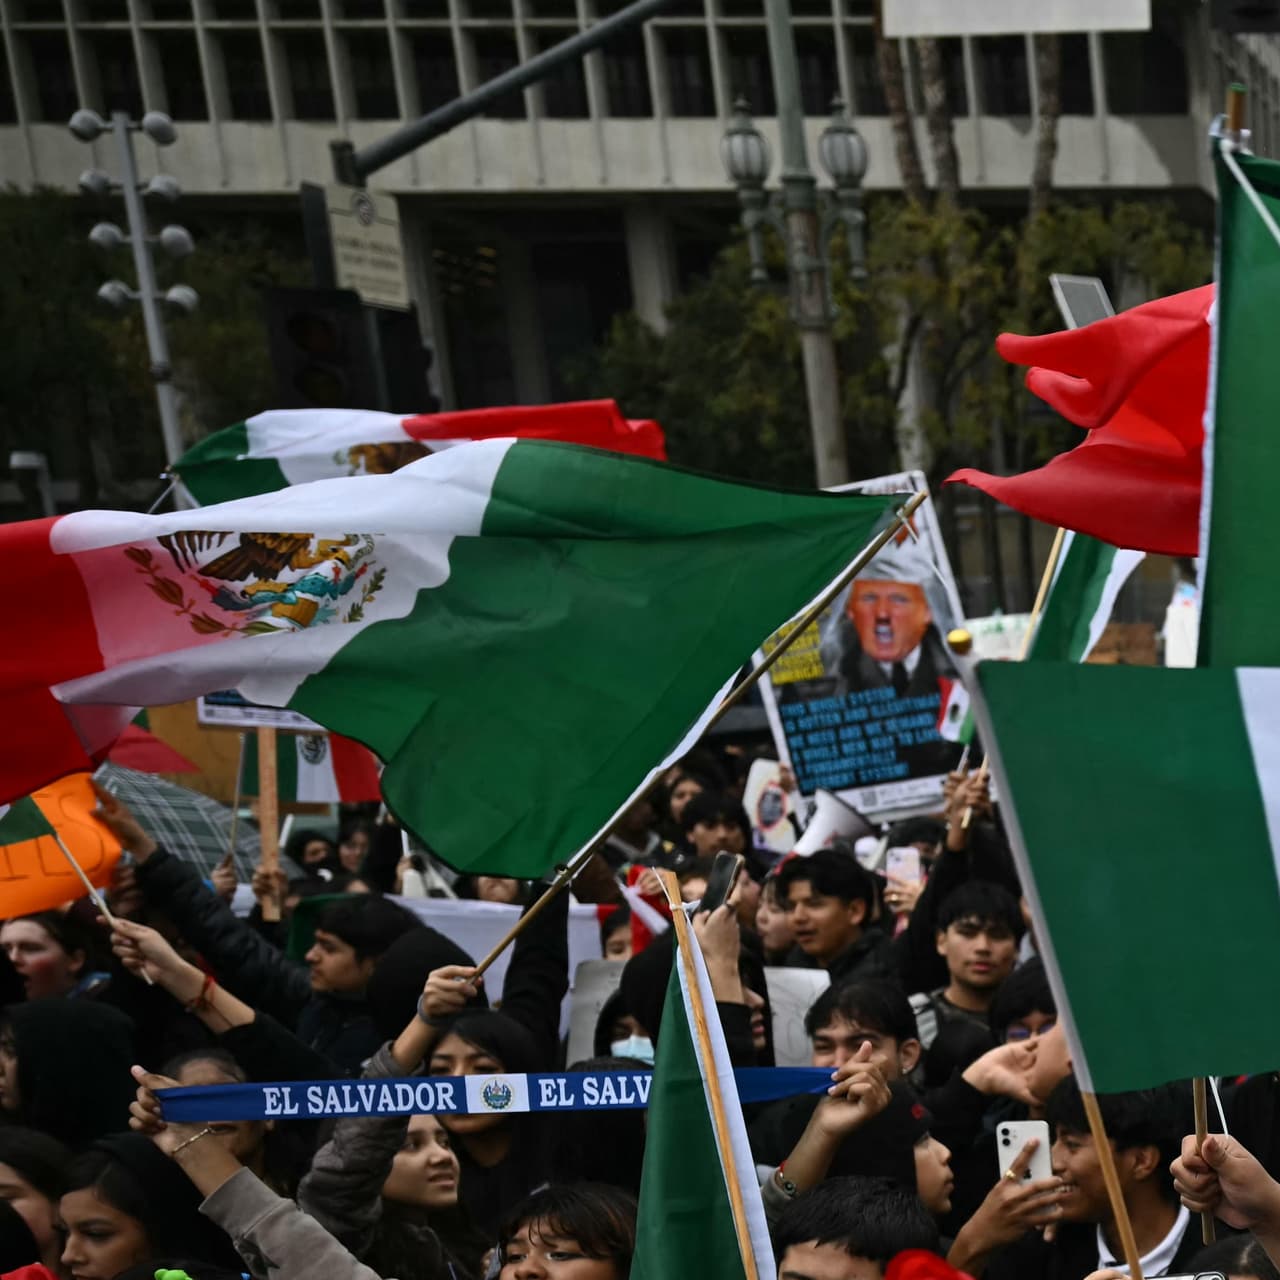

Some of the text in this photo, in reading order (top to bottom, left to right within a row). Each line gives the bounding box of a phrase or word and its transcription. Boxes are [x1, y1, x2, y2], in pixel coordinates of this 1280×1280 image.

[263, 1082, 457, 1116] EL SALVADOR
[538, 1077, 575, 1108] EL
